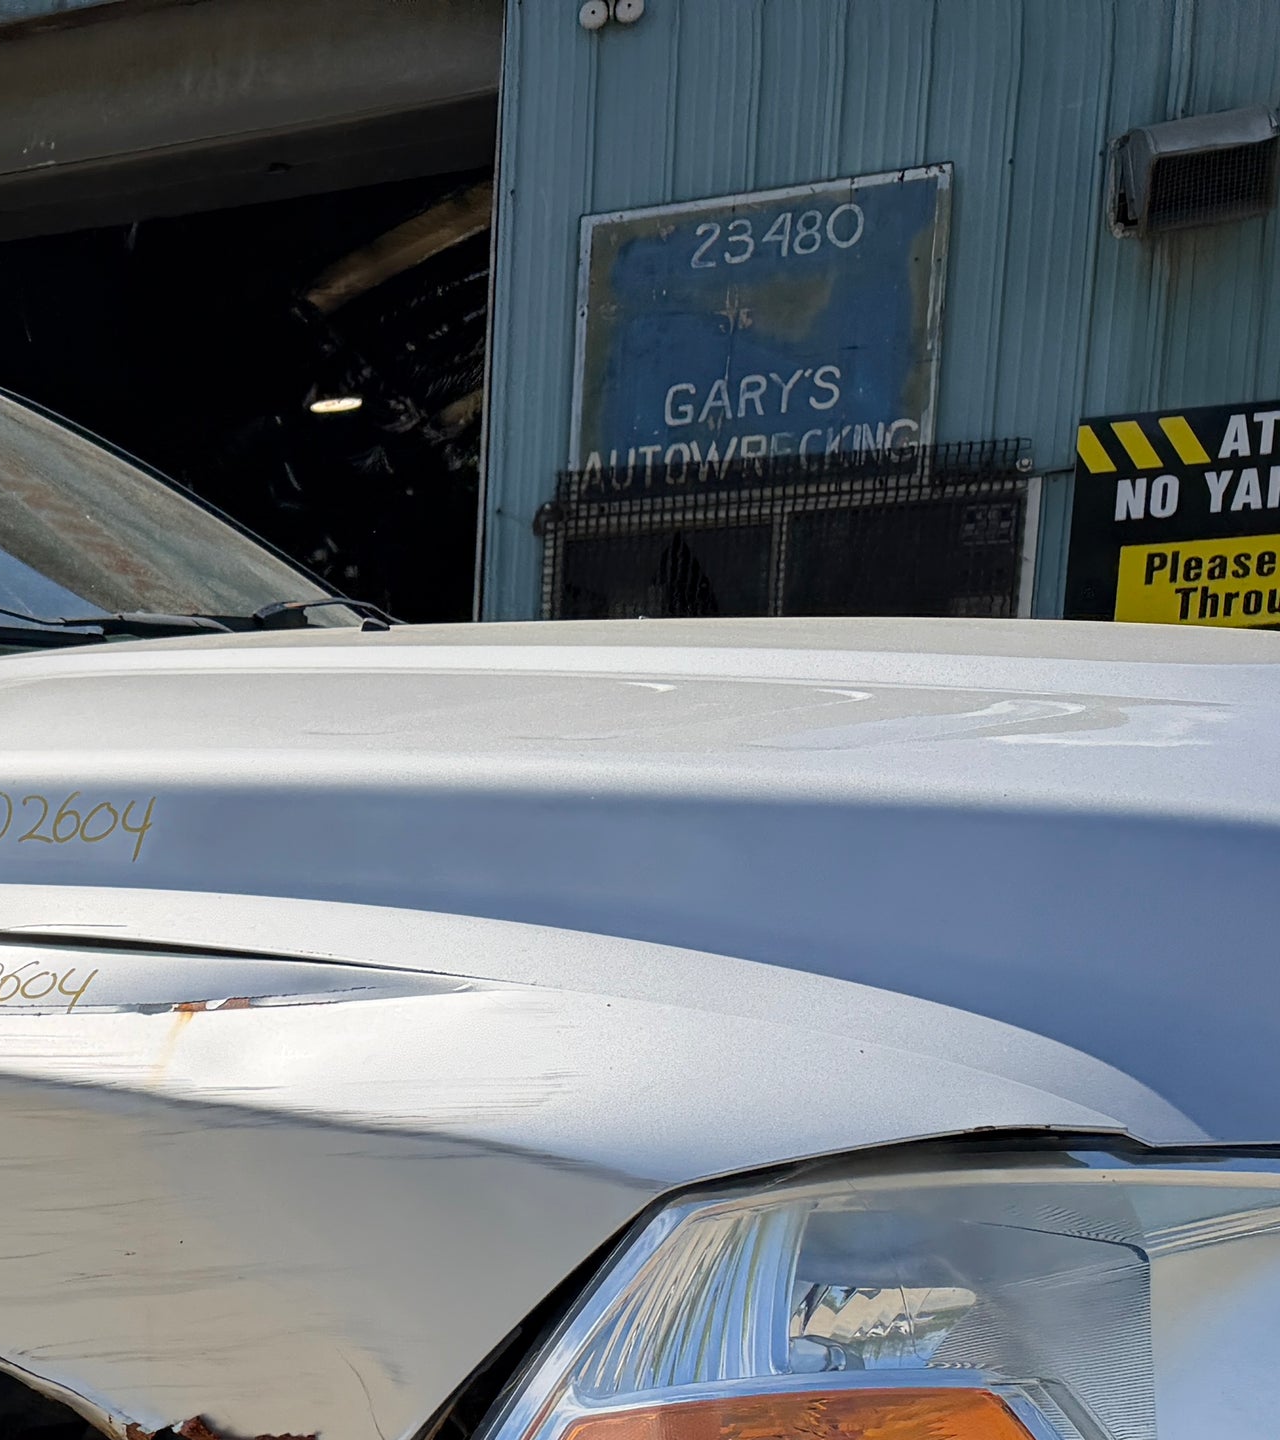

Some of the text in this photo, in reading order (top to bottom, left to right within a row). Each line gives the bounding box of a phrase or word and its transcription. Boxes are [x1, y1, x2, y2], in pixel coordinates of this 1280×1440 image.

[691, 203, 864, 268] 23480
[664, 365, 841, 426] GARY'S
[579, 418, 919, 495] AUTOWRECKING
[1114, 474, 1180, 521] NO
[1144, 551, 1277, 585] Please
